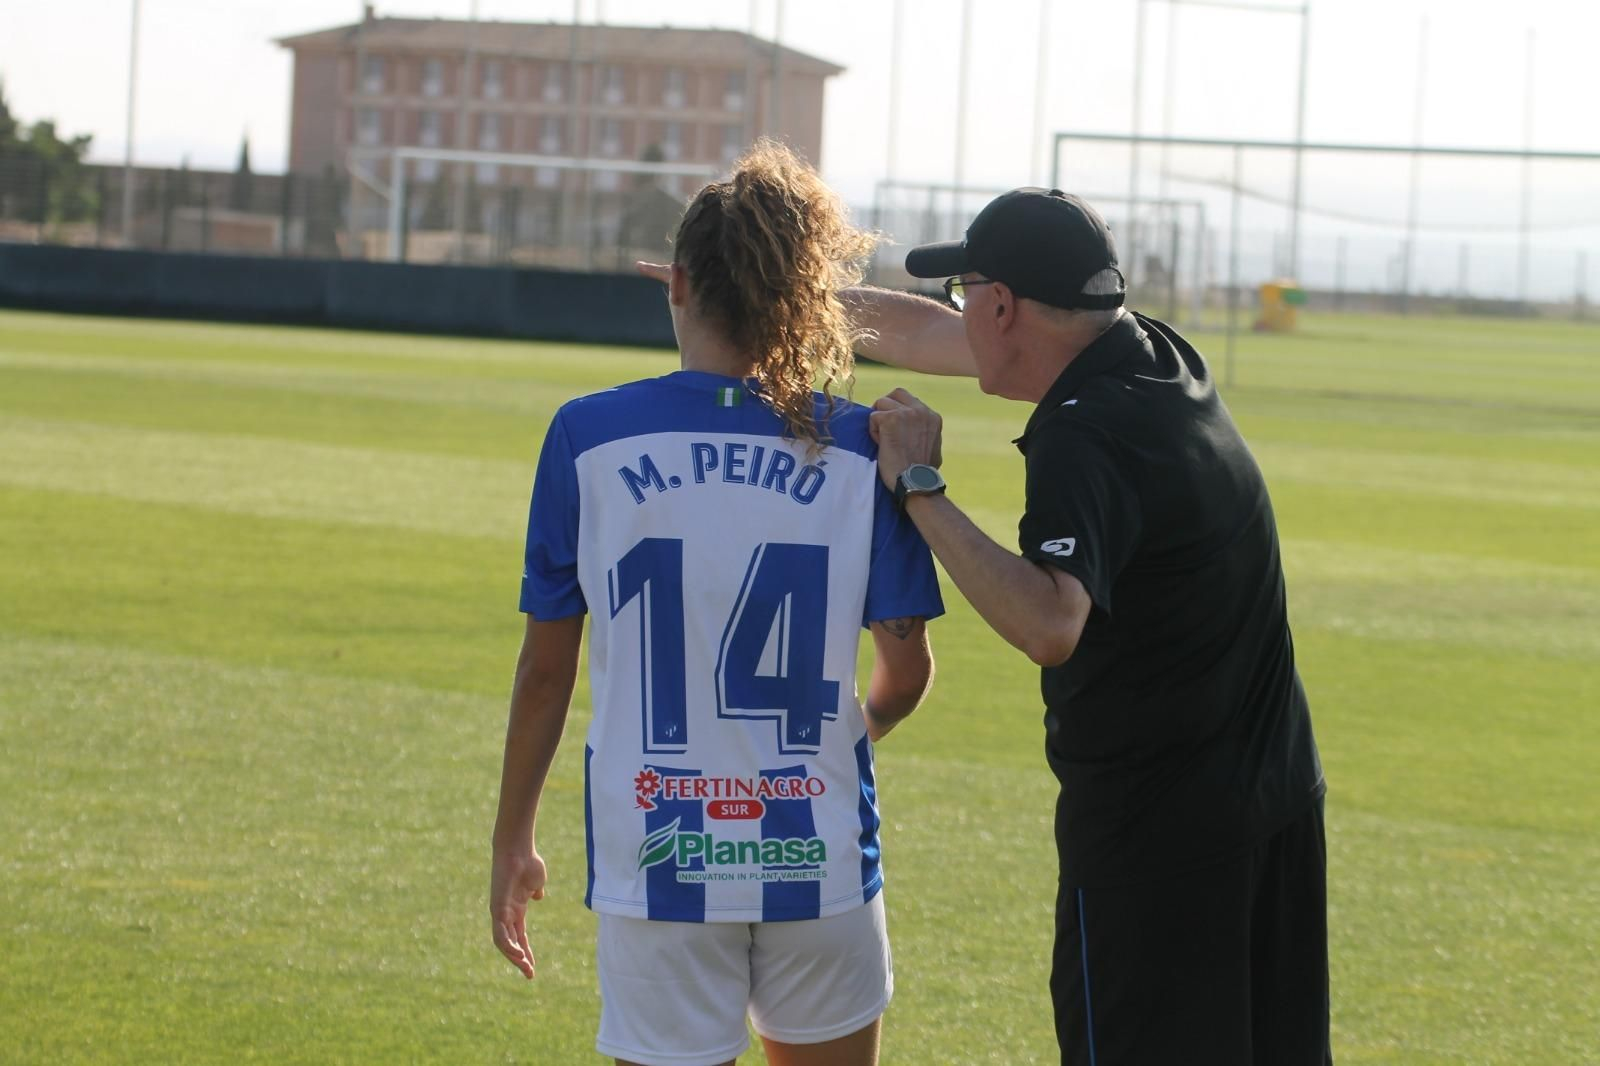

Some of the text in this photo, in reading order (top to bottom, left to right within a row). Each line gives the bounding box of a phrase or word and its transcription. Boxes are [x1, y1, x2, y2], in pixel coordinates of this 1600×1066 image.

[618, 442, 829, 505] M. PEIRÓ
[608, 537, 840, 755] 14
[664, 777, 826, 798] FERTINAGRO
[721, 804, 749, 815] SUR
[678, 833, 827, 865] Planasa
[678, 870, 828, 881] INNOVATION IN PLANT VARIETIES
